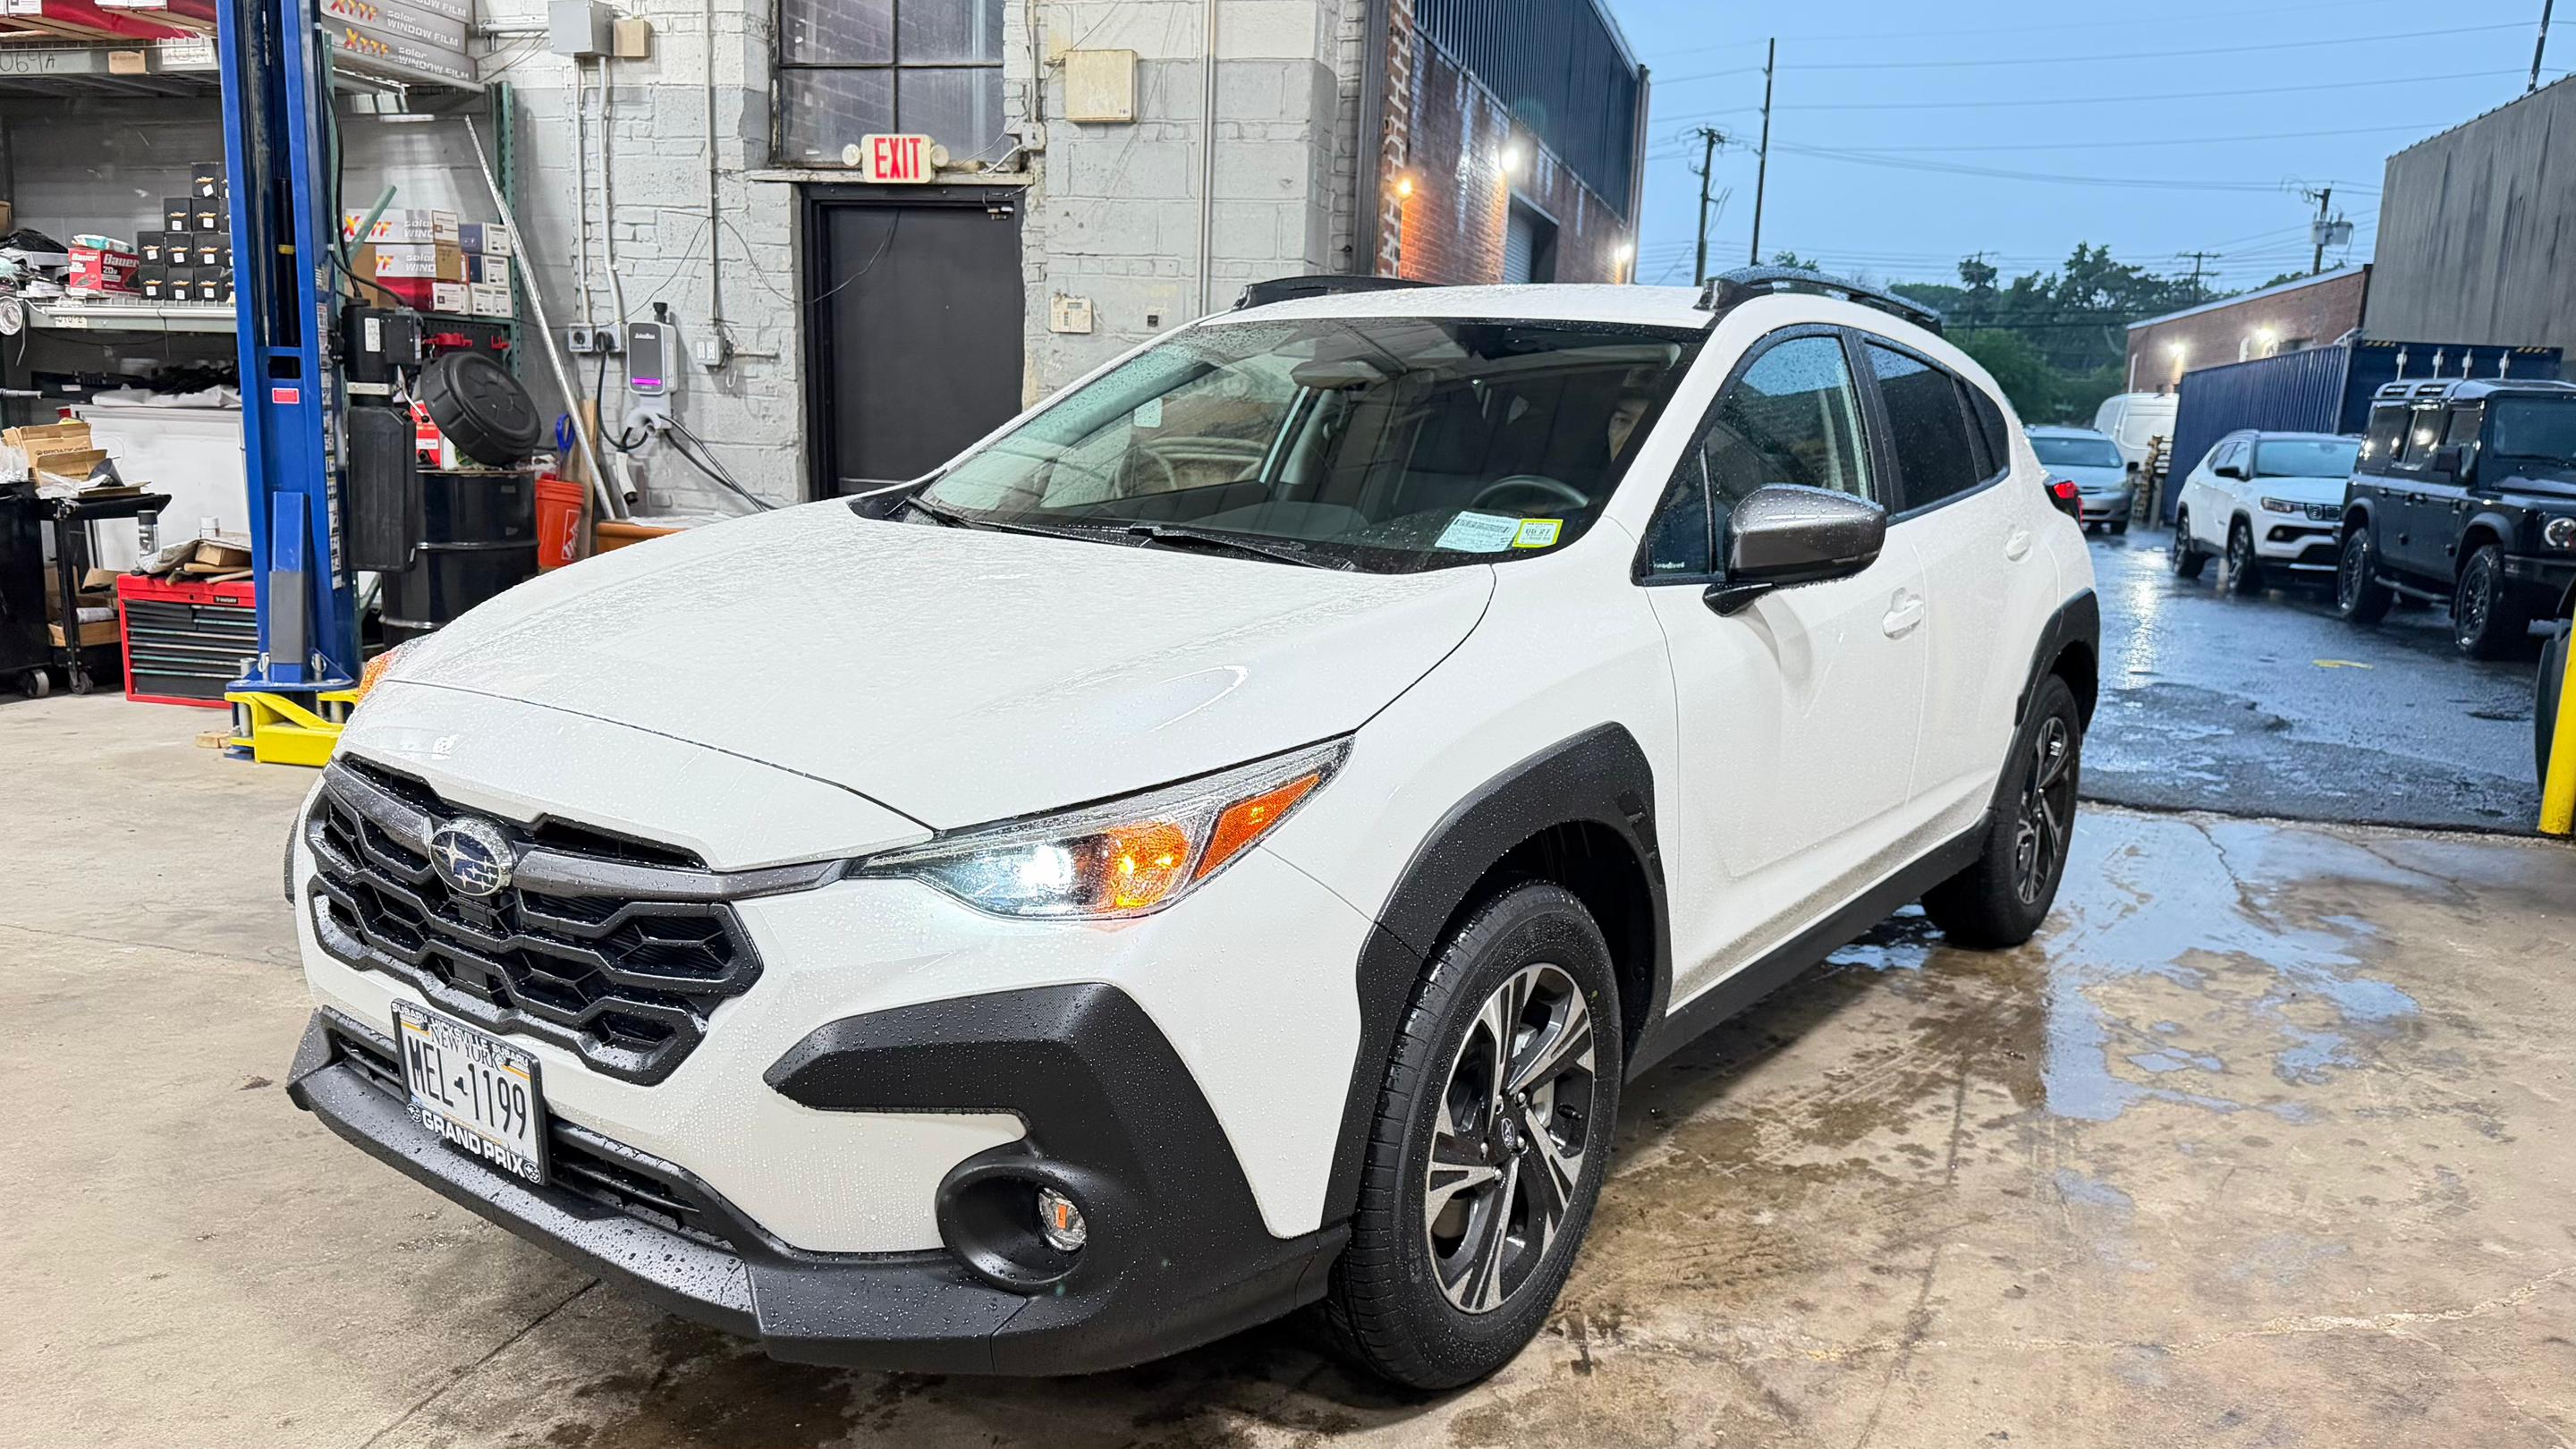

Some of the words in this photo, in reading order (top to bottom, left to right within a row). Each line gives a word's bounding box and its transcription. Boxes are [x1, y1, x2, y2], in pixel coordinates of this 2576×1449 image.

[387, 10, 416, 23] solar
[442, 3, 467, 17] FILM
[387, 19, 432, 39] WINDOW
[434, 32, 459, 47] FILM
[398, 47, 428, 59] solar
[875, 138, 920, 179] EXIT
[103, 253, 140, 268] Bauer
[392, 1004, 428, 1023] SUBARU
[430, 1017, 488, 1049] HICKSVILLE
[492, 1044, 530, 1067] SUBARU
[430, 1026, 460, 1053] NEW
[464, 1043, 502, 1072] YORK
[407, 1035, 454, 1107] MEL
[467, 1063, 527, 1140] 1199
[421, 1109, 482, 1155] GRAND
[483, 1140, 526, 1178] PRIX
